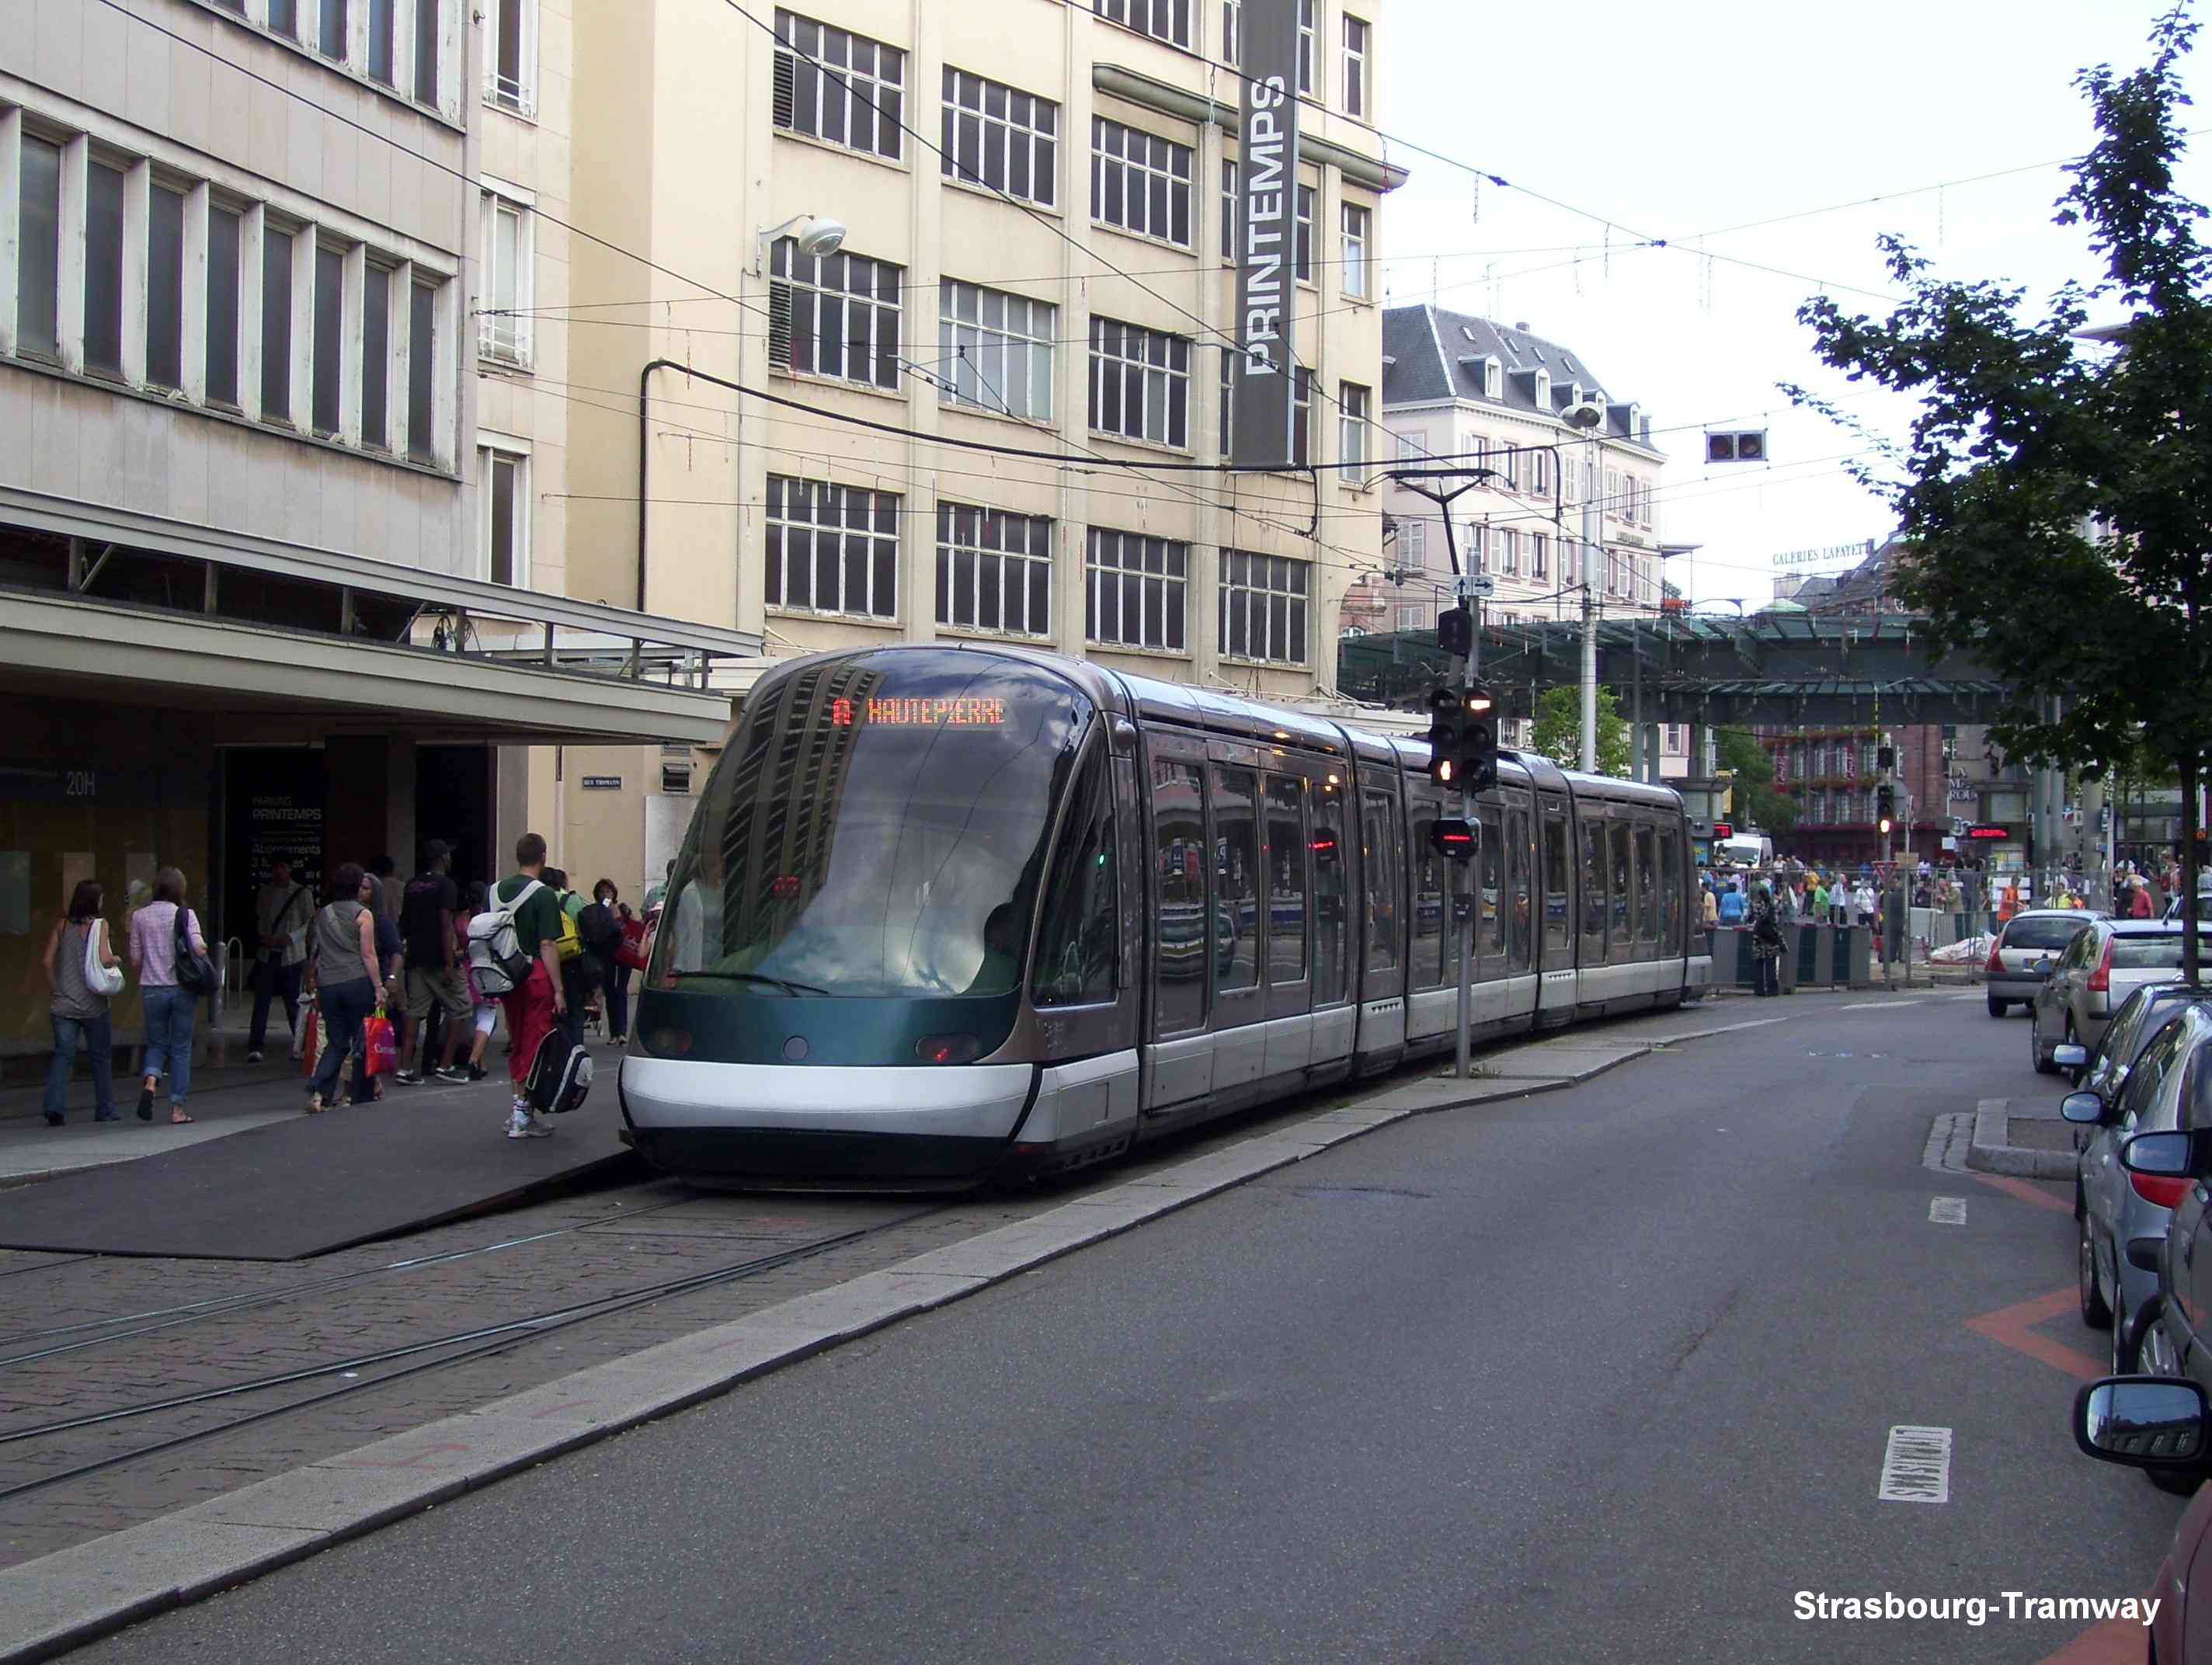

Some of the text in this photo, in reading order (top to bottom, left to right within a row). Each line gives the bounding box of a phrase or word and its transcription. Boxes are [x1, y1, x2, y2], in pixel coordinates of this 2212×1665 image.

[1246, 75, 1285, 376] PRINTEMPS
[1772, 542, 1869, 565] GALERIES LAFAYETT
[868, 697, 1007, 724] HAUTEPIERRE
[66, 770, 96, 795] 20H
[252, 808, 322, 820] PRINTEMPS
